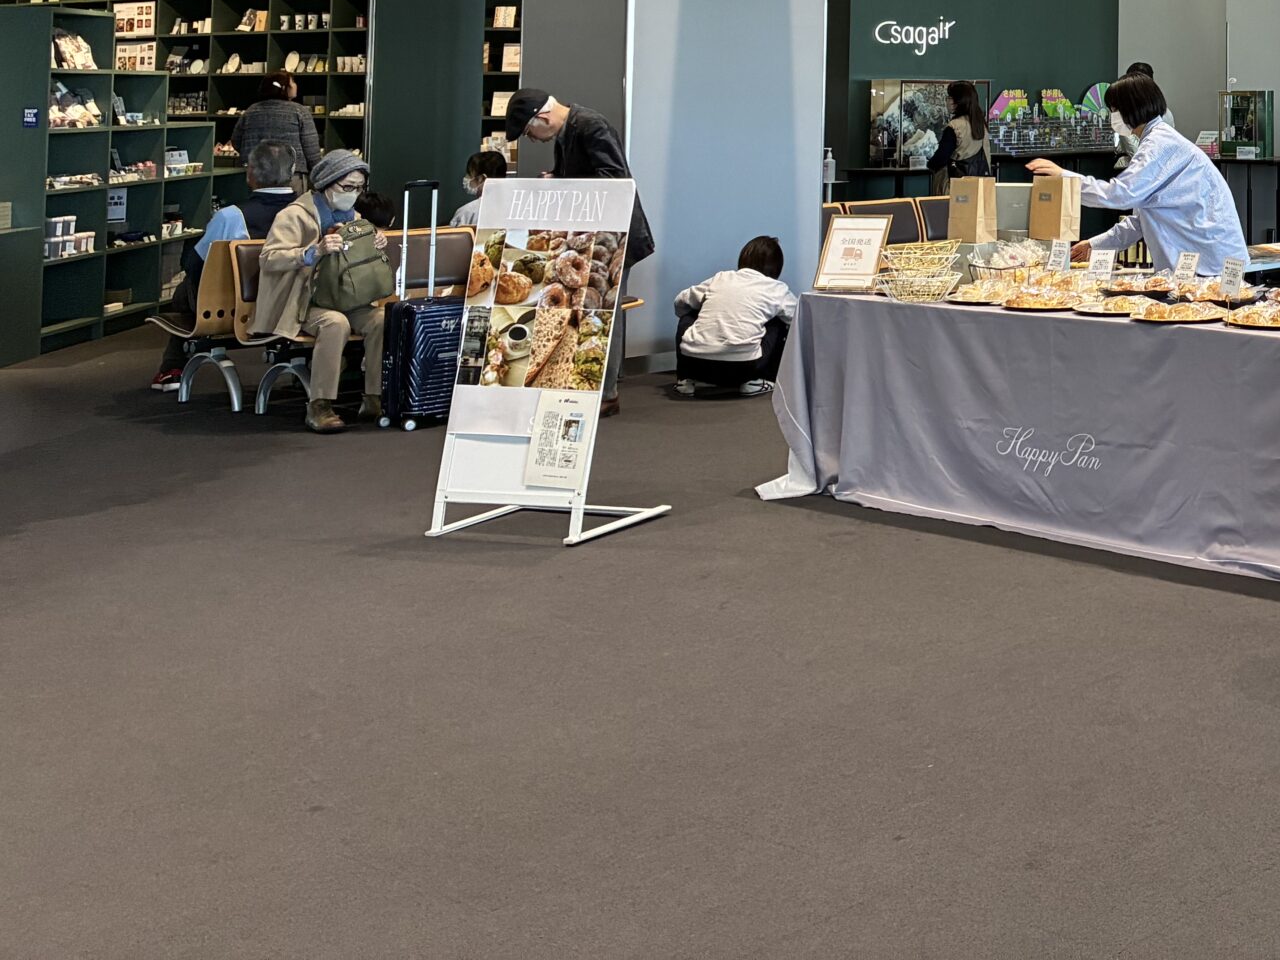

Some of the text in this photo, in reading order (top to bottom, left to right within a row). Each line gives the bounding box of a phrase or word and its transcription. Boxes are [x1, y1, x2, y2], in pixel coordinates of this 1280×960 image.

[506, 189, 608, 222] HAPPY PAN
[996, 426, 1101, 477] Happy Pan
